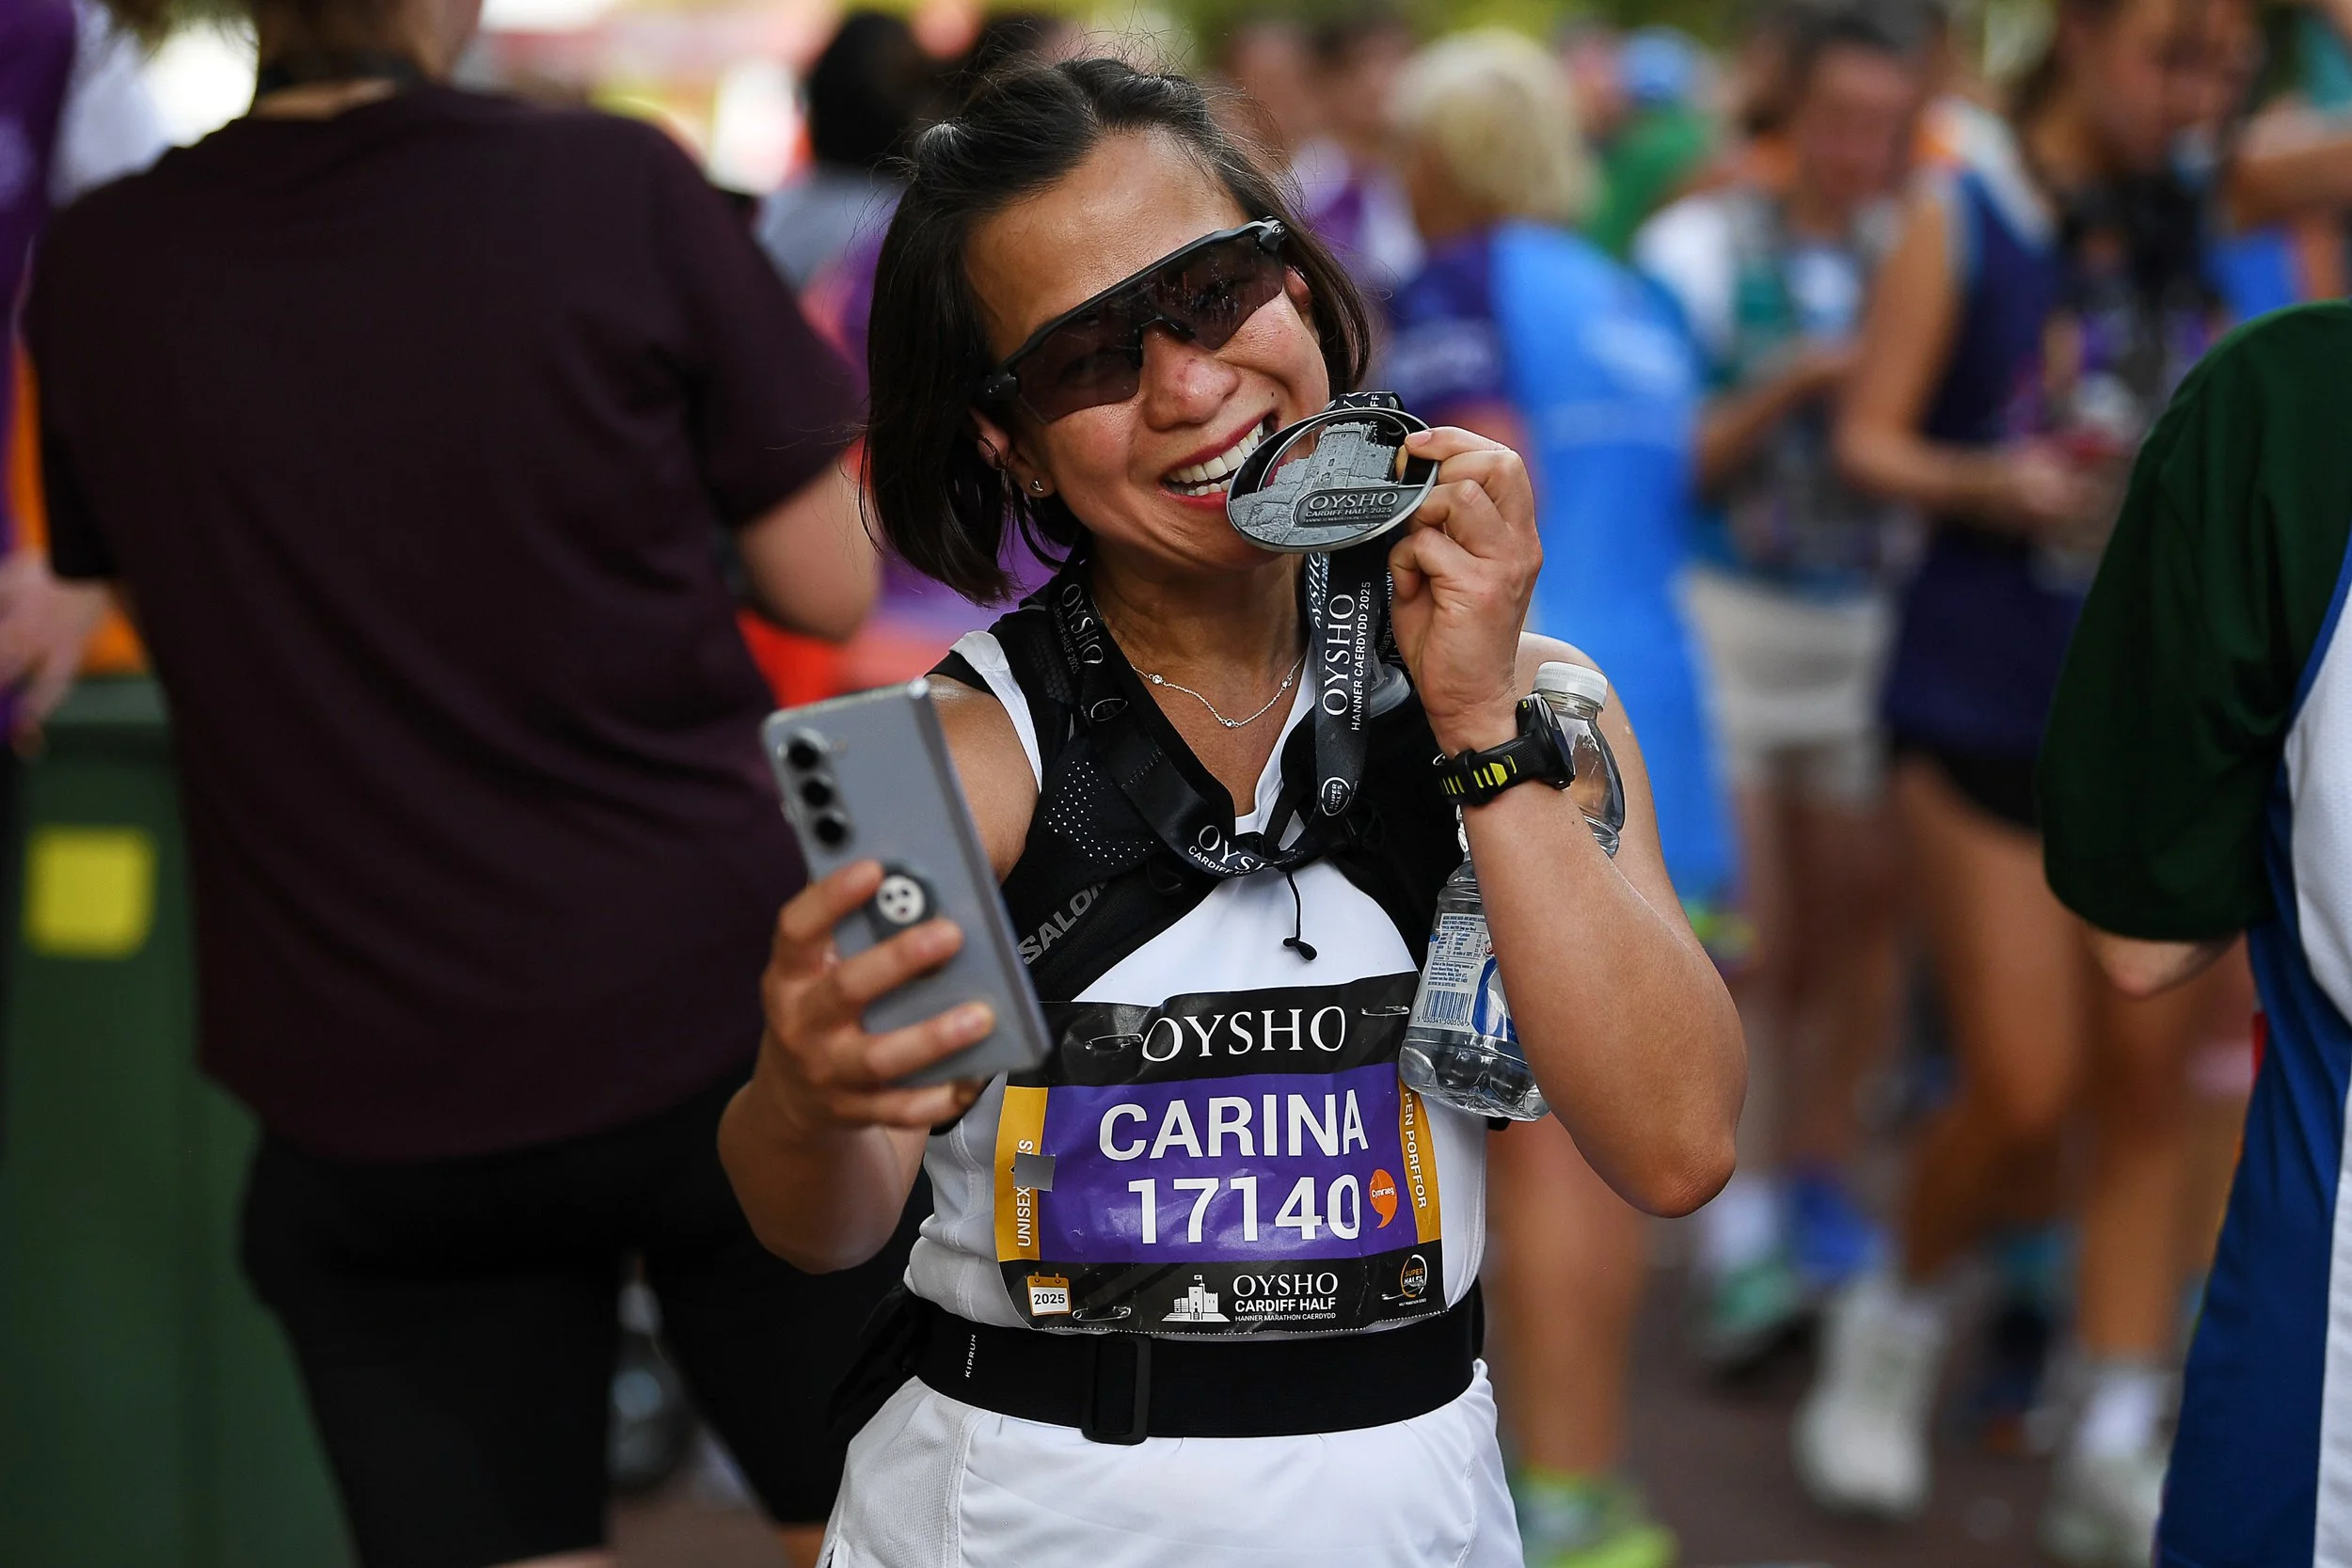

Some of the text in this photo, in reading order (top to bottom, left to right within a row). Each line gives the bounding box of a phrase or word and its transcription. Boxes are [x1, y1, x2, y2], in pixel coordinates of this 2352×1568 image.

[1305, 509, 1344, 517] CARDIFF
[1309, 491, 1398, 510] OYSHO
[1323, 594, 1355, 716] OYSHO
[1351, 581, 1371, 731] HANNER CAERDYDD 2025
[1141, 1006, 1346, 1062] OYSHO
[1099, 1088, 1369, 1162] CARINA
[1405, 1092, 1427, 1209] PEN PORFFOR
[1017, 1186, 1031, 1247] UNISEX
[1128, 1174, 1360, 1244] 17140
[1033, 1293, 1065, 1306] 2025
[1232, 1272, 1338, 1297] OYSHO
[1234, 1297, 1336, 1313] CARDIFF HALF
[1263, 1313, 1301, 1322] MARATHON
[1302, 1312, 1336, 1321] CAERDYDD
[964, 1334, 976, 1378] KIPRUN
